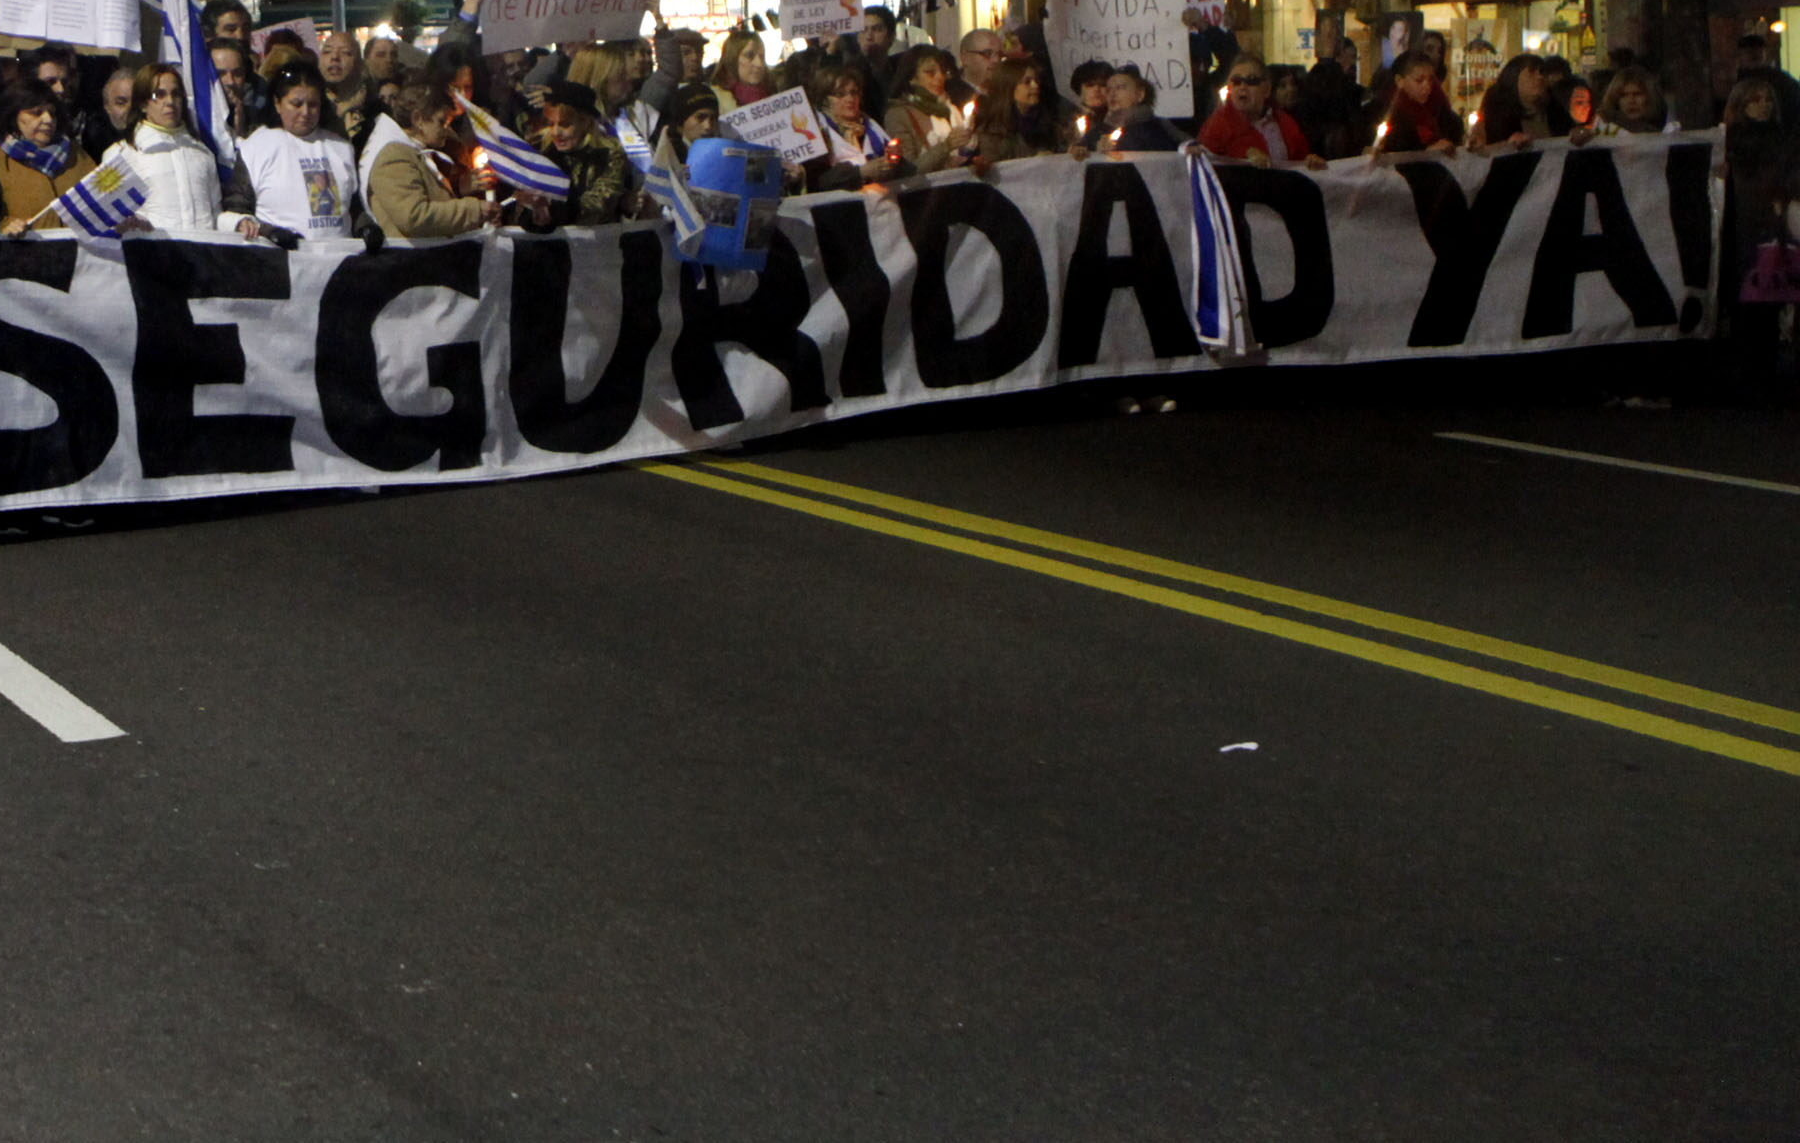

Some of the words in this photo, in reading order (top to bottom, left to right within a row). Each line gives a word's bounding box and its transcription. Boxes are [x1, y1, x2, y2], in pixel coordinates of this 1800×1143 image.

[792, 18, 853, 35] PRESENTE
[726, 111, 749, 127] POR
[750, 91, 804, 120] SEGURIDAD
[1398, 144, 1712, 347] YA!
